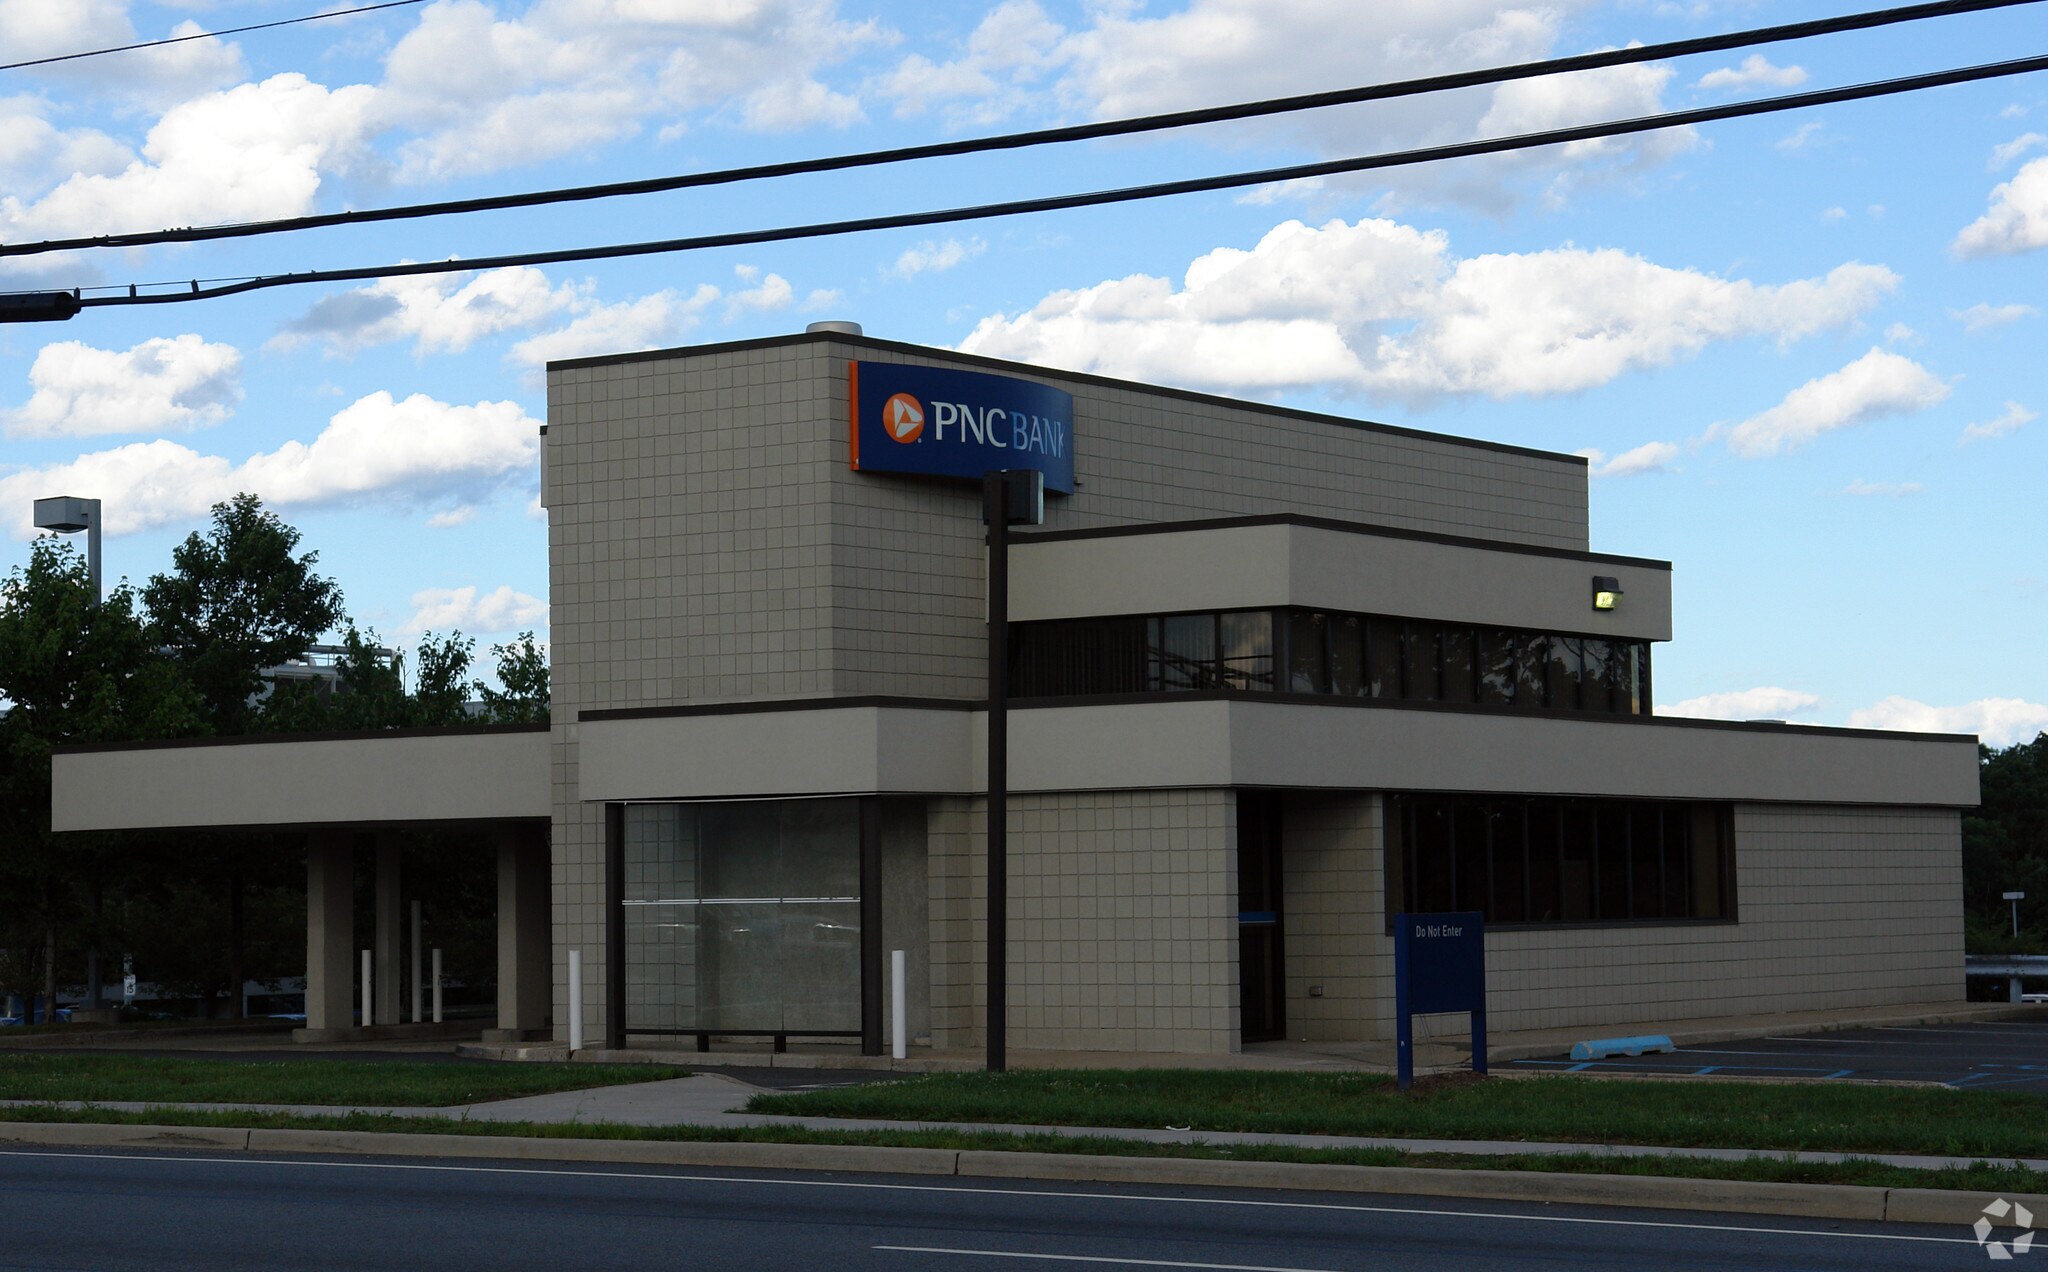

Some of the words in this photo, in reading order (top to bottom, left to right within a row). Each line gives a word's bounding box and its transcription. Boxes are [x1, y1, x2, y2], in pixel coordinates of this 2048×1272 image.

[931, 401, 1007, 447] PNC
[1009, 411, 1066, 459] BANK
[1415, 925, 1426, 938] Do
[1427, 925, 1441, 938] Not
[1442, 925, 1463, 937] Enter
